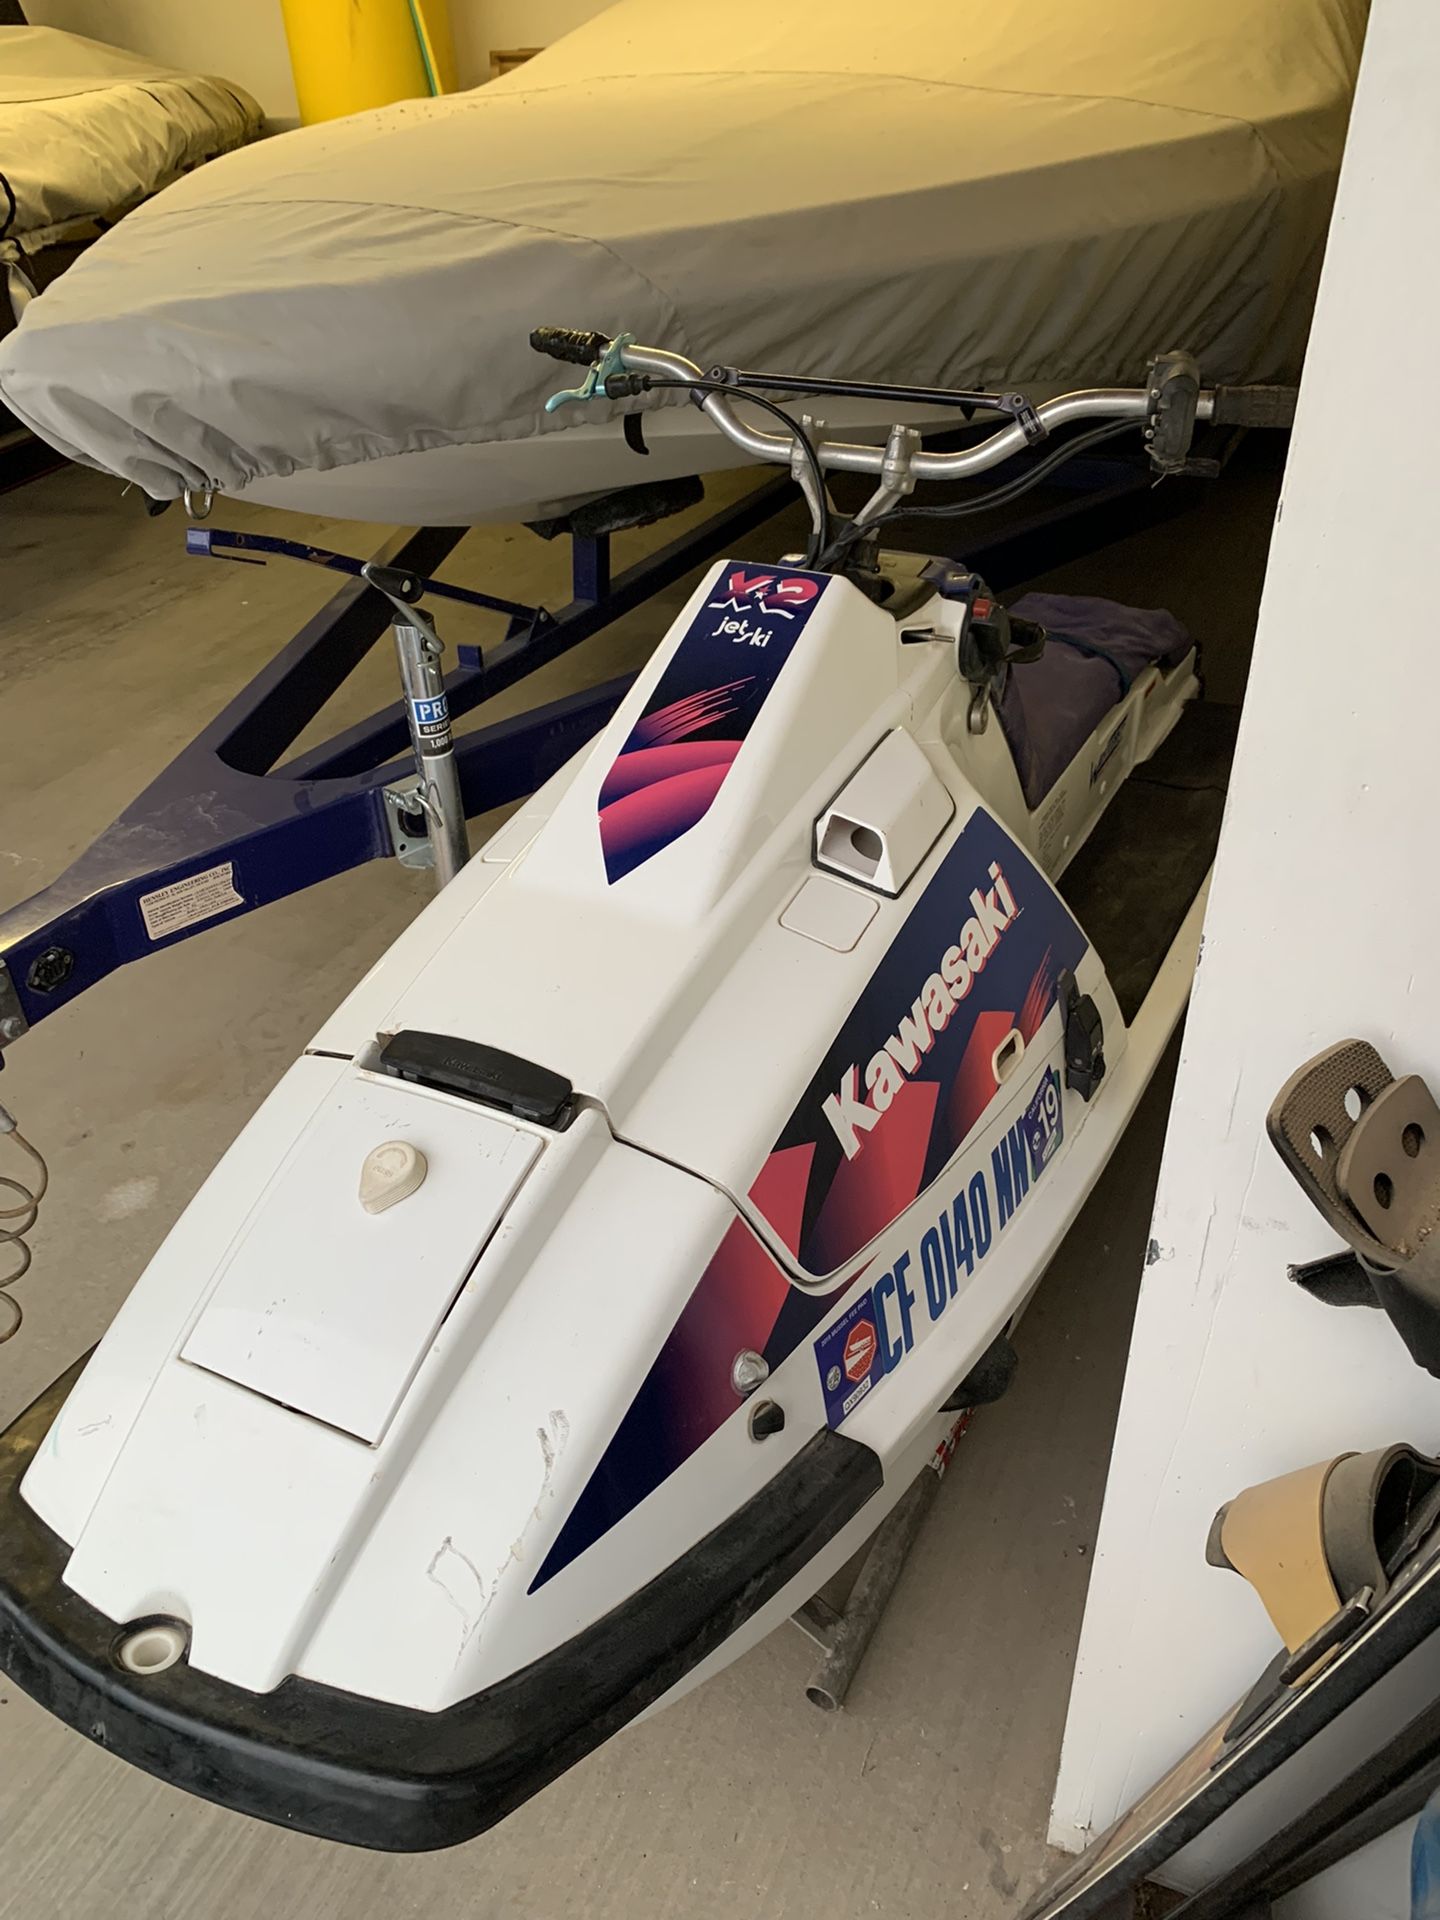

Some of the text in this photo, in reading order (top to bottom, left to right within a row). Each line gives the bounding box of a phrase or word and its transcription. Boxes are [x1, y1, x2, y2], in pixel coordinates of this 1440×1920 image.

[820, 860, 1019, 1161] Kawasaki
[1038, 1083, 1059, 1141] 19
[871, 1250, 916, 1374] CF
[920, 1170, 992, 1322] 0140
